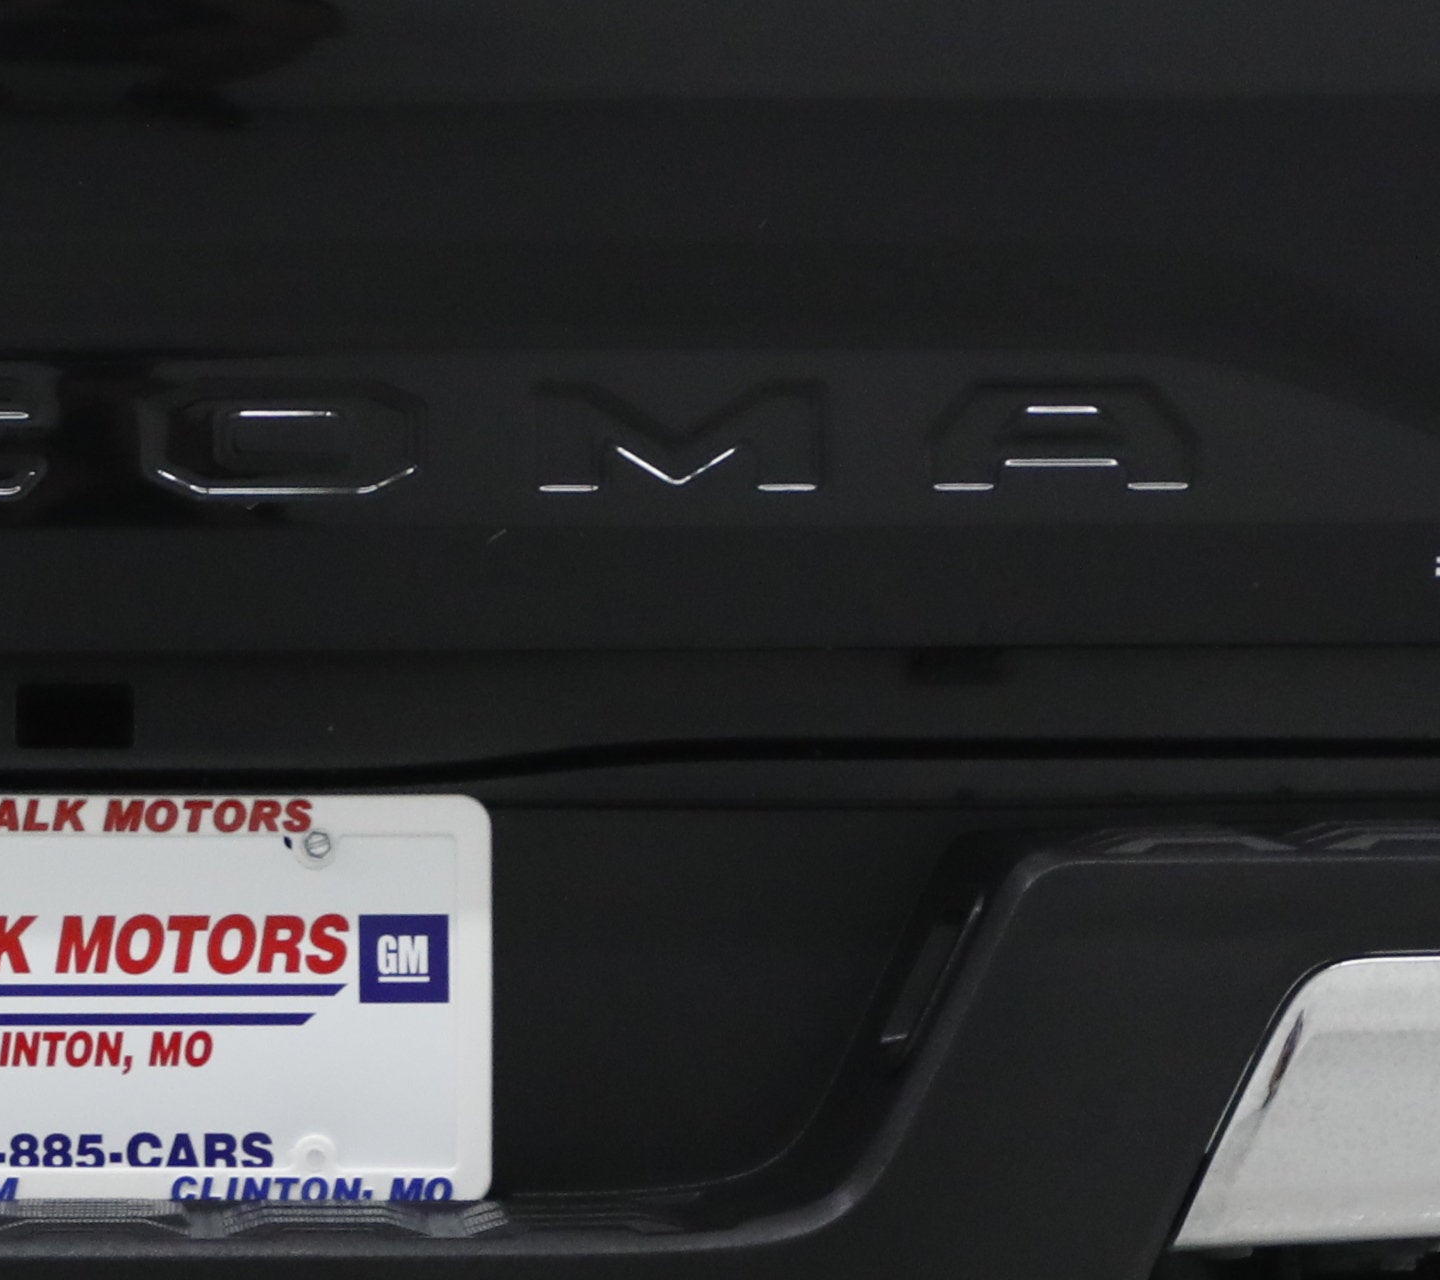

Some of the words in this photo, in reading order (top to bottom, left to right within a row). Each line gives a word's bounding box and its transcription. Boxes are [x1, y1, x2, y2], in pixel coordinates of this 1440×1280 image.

[104, 798, 313, 833] MOTORS
[54, 913, 350, 976] MOTORS
[377, 933, 429, 976] GM
[149, 1030, 214, 1068] MO
[389, 1176, 454, 1202] MO
